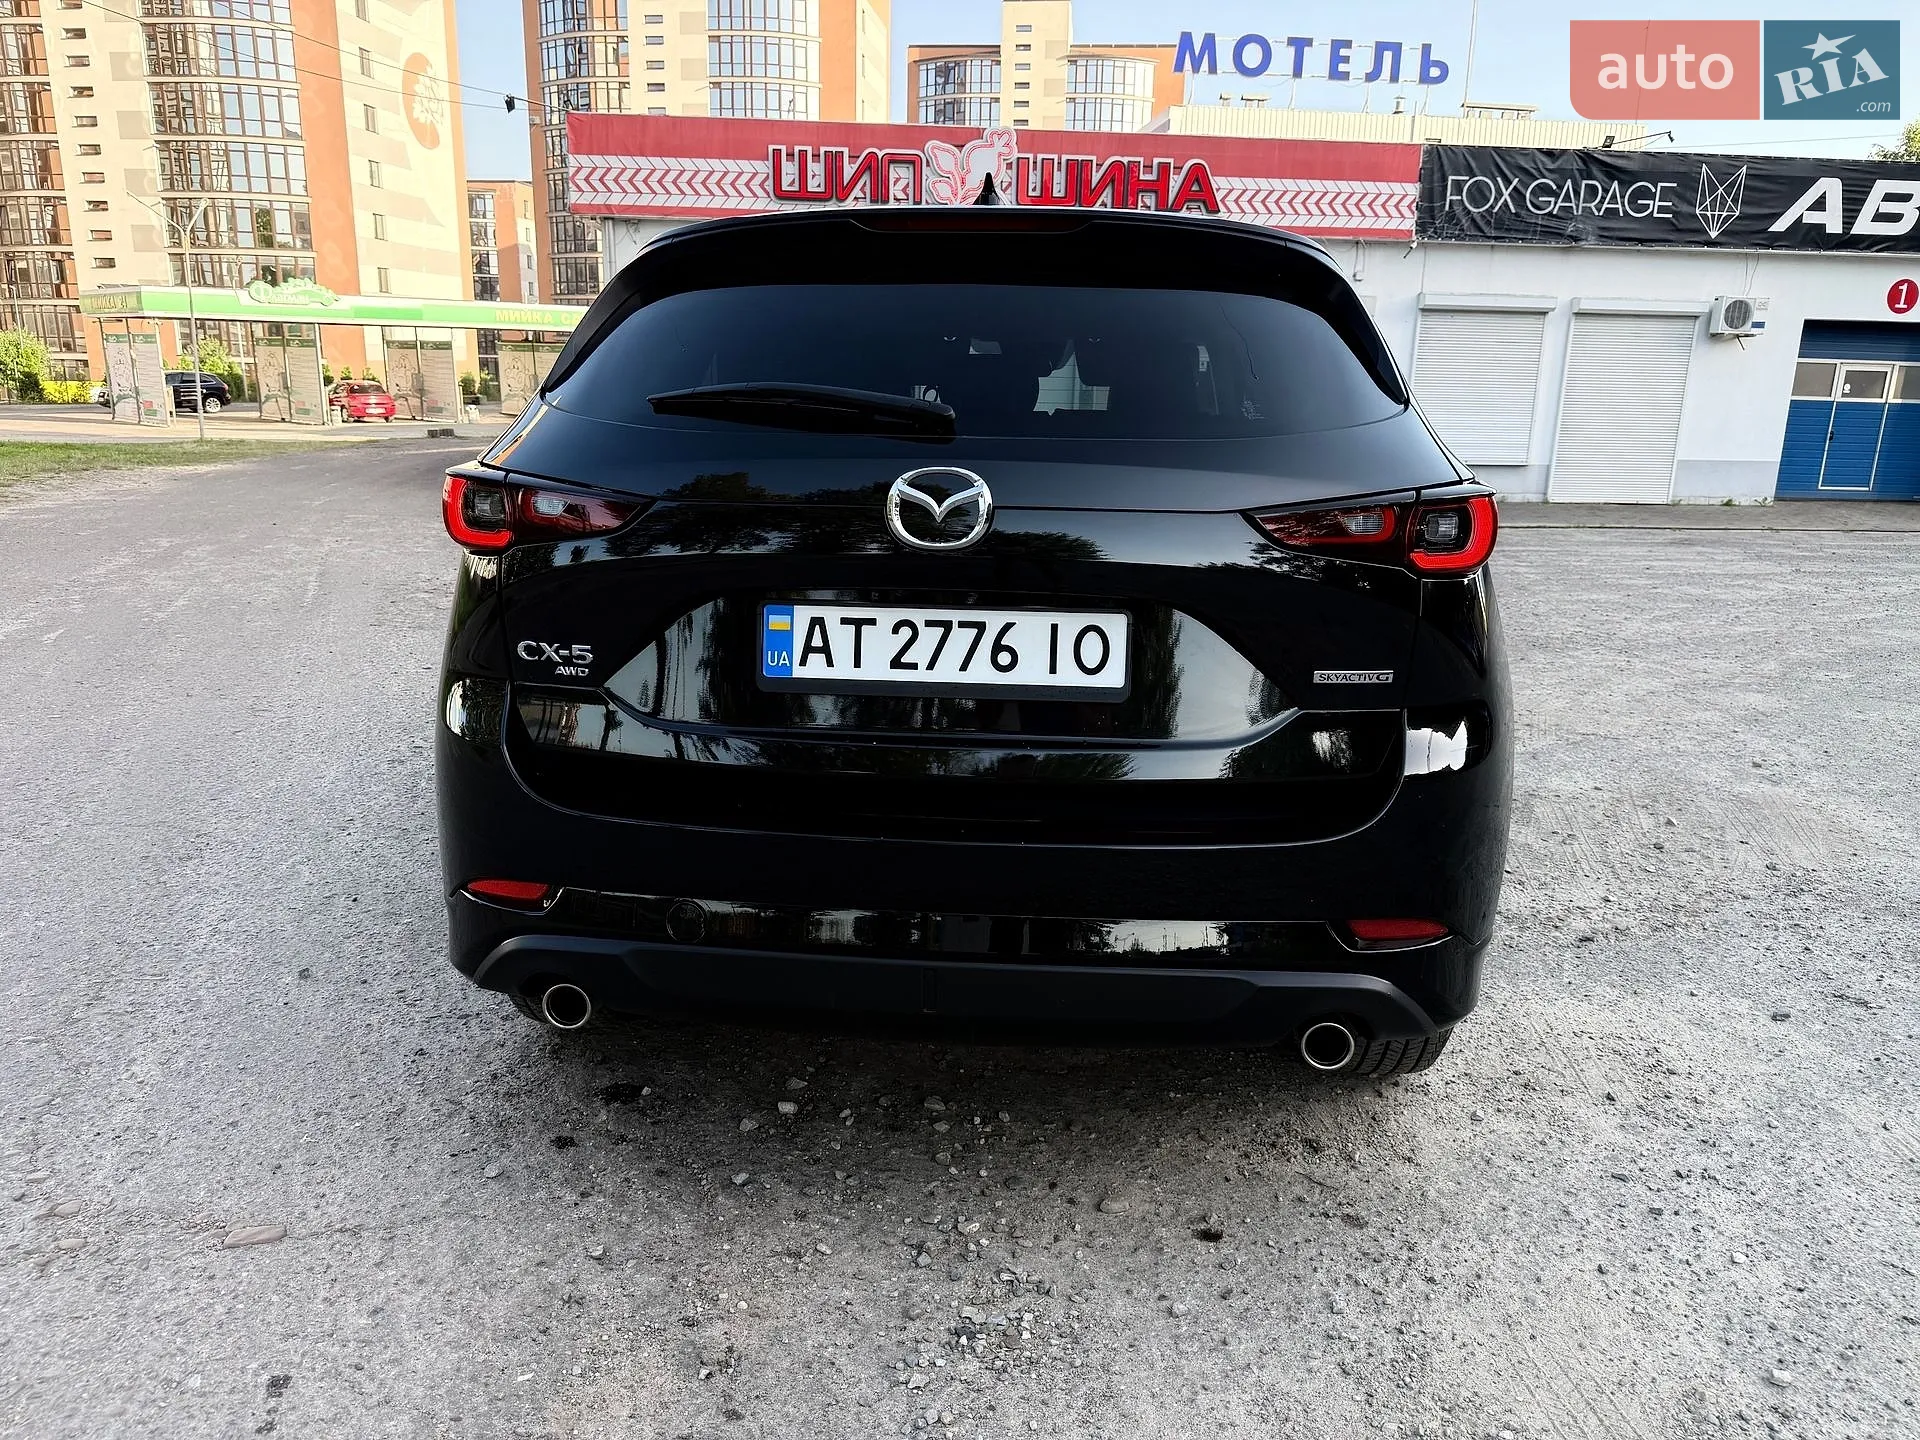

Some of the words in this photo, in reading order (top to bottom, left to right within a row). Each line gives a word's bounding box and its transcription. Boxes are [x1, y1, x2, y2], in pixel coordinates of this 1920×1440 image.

[1173, 31, 1449, 85] МОТЕЛЬ
[770, 146, 923, 205] ШИП
[1015, 155, 1221, 213] ШИНА
[1443, 174, 1524, 215] FOX
[1524, 176, 1678, 219] GARAGE
[1894, 281, 1909, 309] 1
[496, 308, 553, 324] МИЙКА
[516, 640, 594, 665] CX-5
[767, 650, 791, 667] UA
[798, 616, 878, 669] AT
[889, 618, 1020, 674] 2776
[555, 665, 589, 677] AWD
